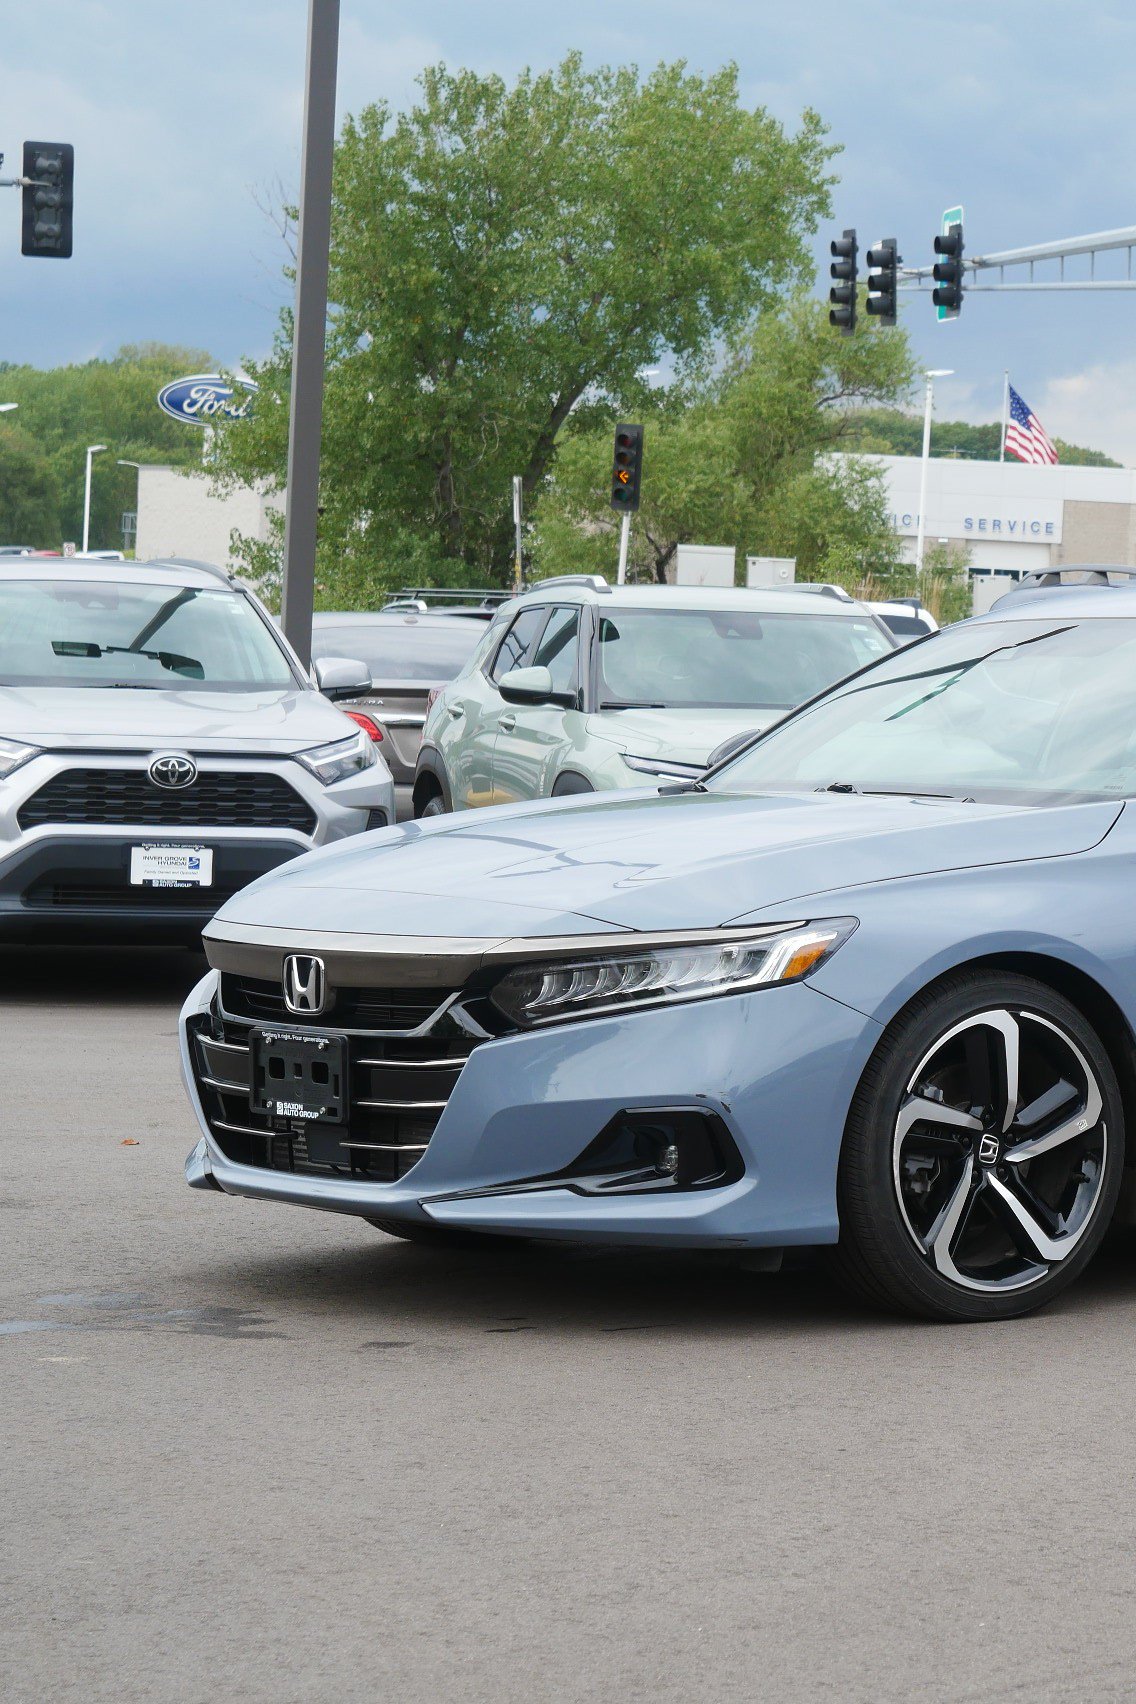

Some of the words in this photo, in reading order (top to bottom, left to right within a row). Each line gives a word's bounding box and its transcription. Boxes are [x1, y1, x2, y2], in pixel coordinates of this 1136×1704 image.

[964, 517, 1054, 534] SERVICE
[284, 1102, 303, 1110] SAXON
[283, 1109, 298, 1117] AUTO
[299, 1111, 319, 1119] GROUP
